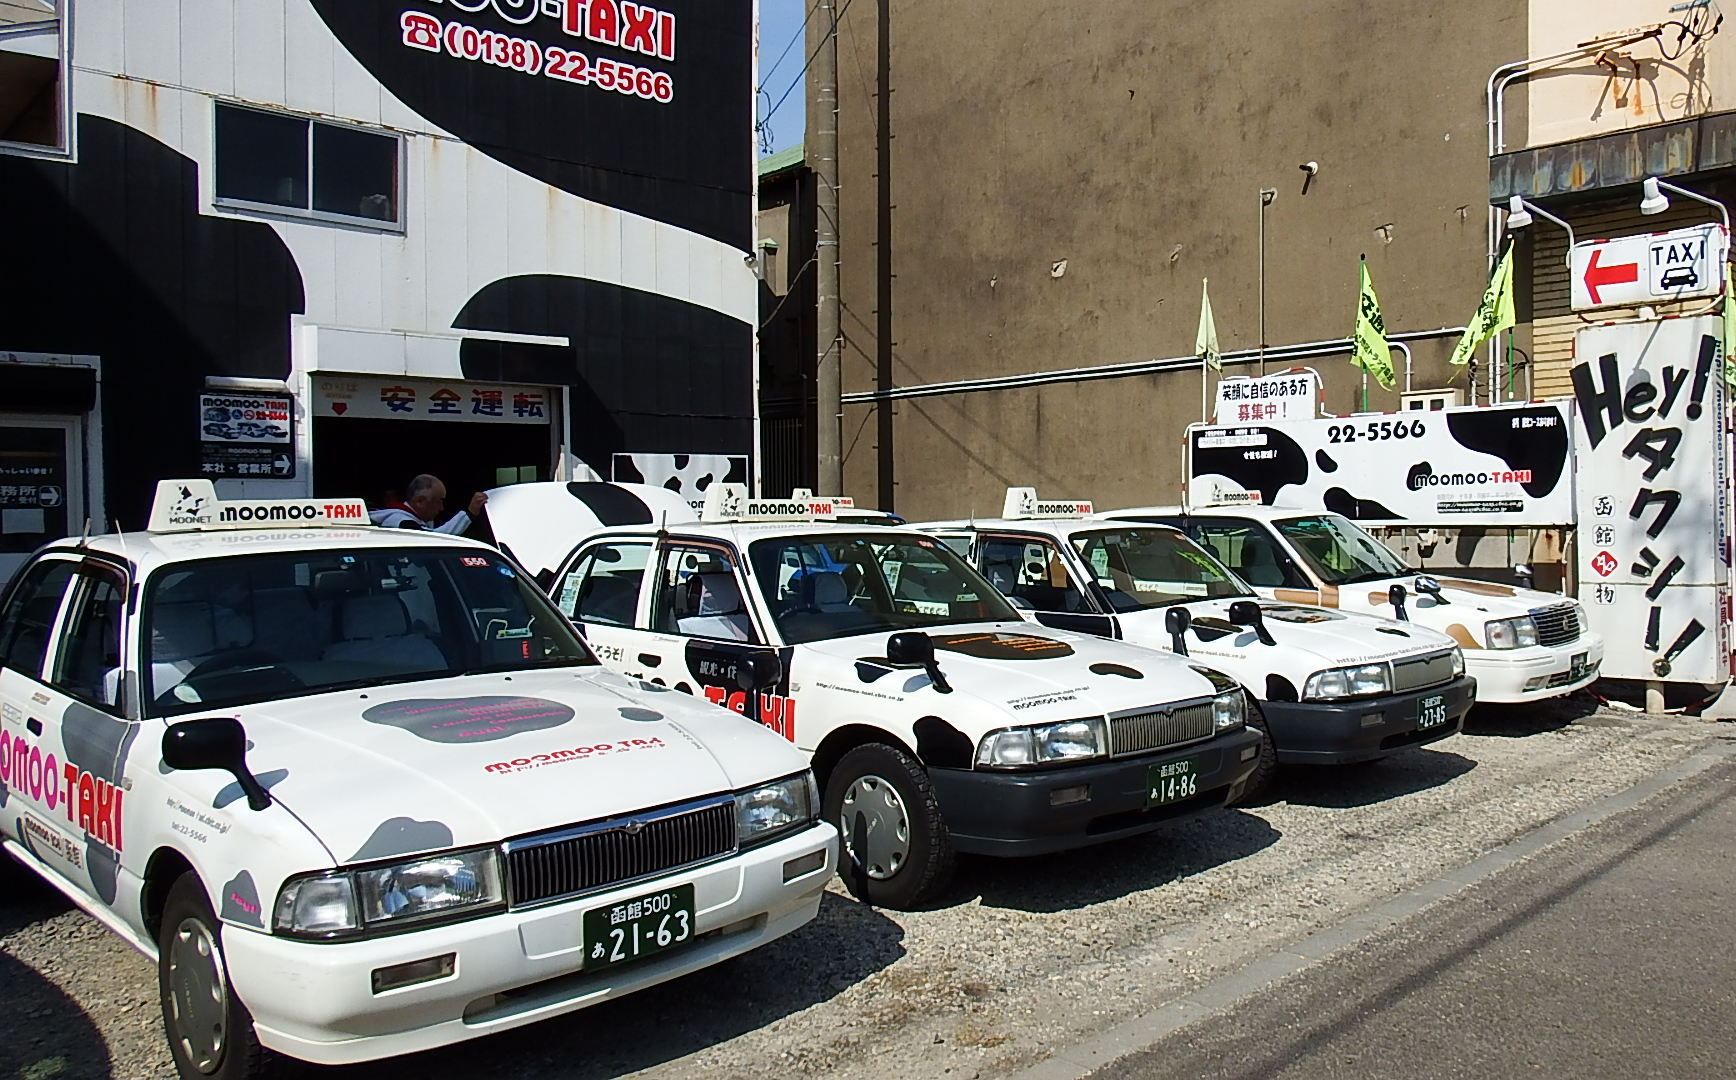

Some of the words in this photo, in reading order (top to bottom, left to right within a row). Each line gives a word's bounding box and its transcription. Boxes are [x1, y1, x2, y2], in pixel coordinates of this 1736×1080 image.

[446, 0, 676, 61] -TAXI
[545, 46, 673, 103] 22-5566
[1652, 240, 1705, 265] TAXI
[380, 385, 544, 418] 安全運転
[1222, 378, 1308, 401] 笑顔に自信のある方
[1569, 334, 1716, 452] Hey!
[203, 398, 288, 410] moomoo-TAXI
[1327, 420, 1426, 443] 22-5566
[1415, 470, 1532, 487] moomoo-TAXI
[169, 516, 212, 524] MOONET
[219, 504, 362, 521] moomoo-TAXI
[749, 503, 832, 515] moomoo-TAXI
[1037, 504, 1091, 514] moomoo-TAXI
[1160, 773, 1196, 803] 14-86
[610, 893, 671, 926] 函館500
[591, 942, 606, 959] あ
[609, 910, 690, 963] 21-63
